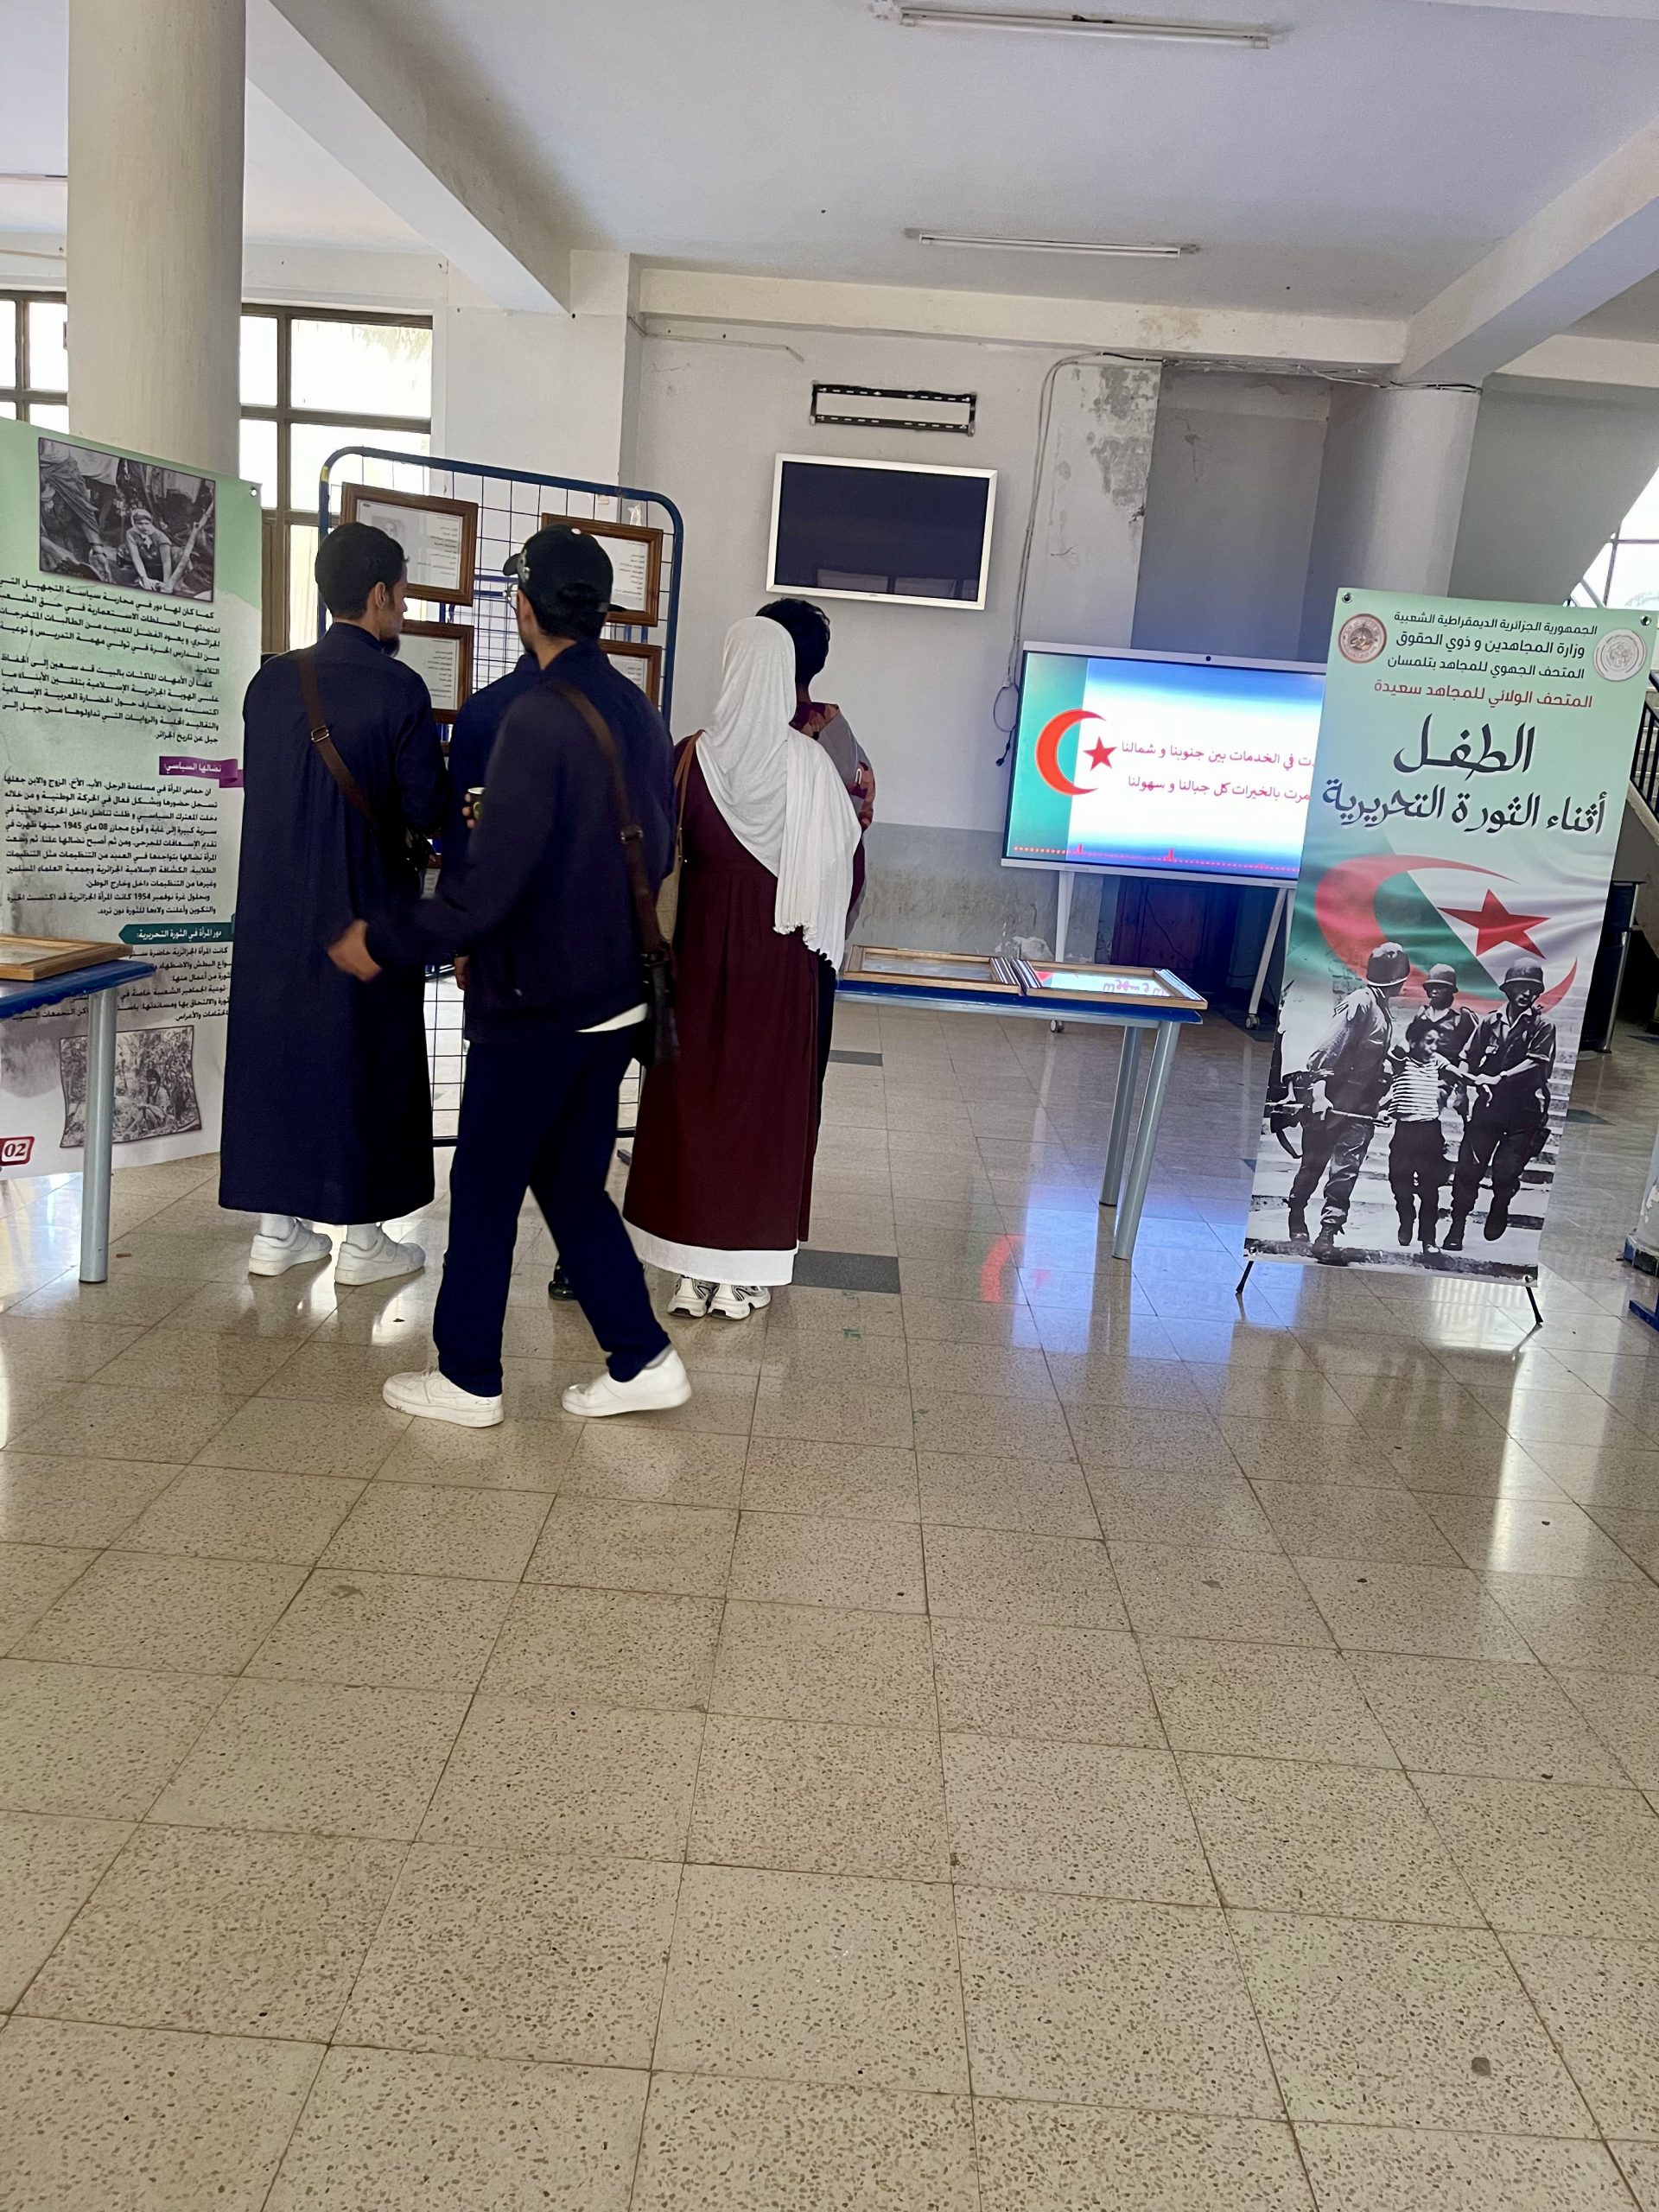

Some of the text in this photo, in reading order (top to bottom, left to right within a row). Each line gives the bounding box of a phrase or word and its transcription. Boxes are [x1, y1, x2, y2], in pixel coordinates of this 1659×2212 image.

[66, 585, 100, 600] سياسة
[38, 597, 62, 607] حق
[103, 592, 134, 605] محاربة
[64, 605, 86, 613] في
[135, 602, 151, 611] في
[163, 604, 181, 614] لها
[44, 614, 83, 626] الطالبات
[140, 615, 181, 626] السلطات
[1394, 611, 1597, 635] الجمهورية الجزائرية الديمقراطية الشعبية
[35, 631, 73, 639] التدريس
[76, 632, 105, 645] مهمة
[130, 645, 149, 653] في
[1395, 631, 1585, 658] وزارة المجاهدين و ذوي الحقوق
[173, 650, 202, 658] المدارس
[1388, 654, 1585, 678] المتحف الجهوي للمجاهد بتلمسان
[1, 669, 16, 677] ما
[157, 675, 187, 685] الأمهات
[43, 688, 77, 701] العربية
[79, 692, 112, 703] الحضارة
[1374, 679, 1592, 708] المتحف الولائي للمجاهد سعيدة
[19, 702, 42, 712] جيل
[114, 697, 136, 707] حول
[101, 712, 123, 722] التي
[1122, 742, 1155, 753] شمالنا
[1393, 713, 1535, 781] الطفل
[1160, 748, 1166, 758] و
[1170, 746, 1204, 760] جنوبنا
[1208, 753, 1225, 763] بين
[1230, 751, 1280, 763] الخدمات
[1283, 753, 1294, 771] في
[1128, 777, 1164, 791] سهولنا
[1168, 783, 1174, 792] و
[1179, 780, 1210, 794] جبالنا
[1213, 782, 1230, 797] كل
[156, 785, 166, 796] في
[1231, 785, 1280, 801] بالخيرات
[41, 791, 74, 802] الوطنية
[77, 792, 99, 803] الحركة
[101, 796, 111, 807] في
[1322, 779, 1608, 835] أثناء الثورة التحريرية
[137, 812, 174, 823] السياسي
[63, 821, 81, 830] 1945
[169, 928, 187, 939] الثورة
[4, 1143, 26, 1157] 02
